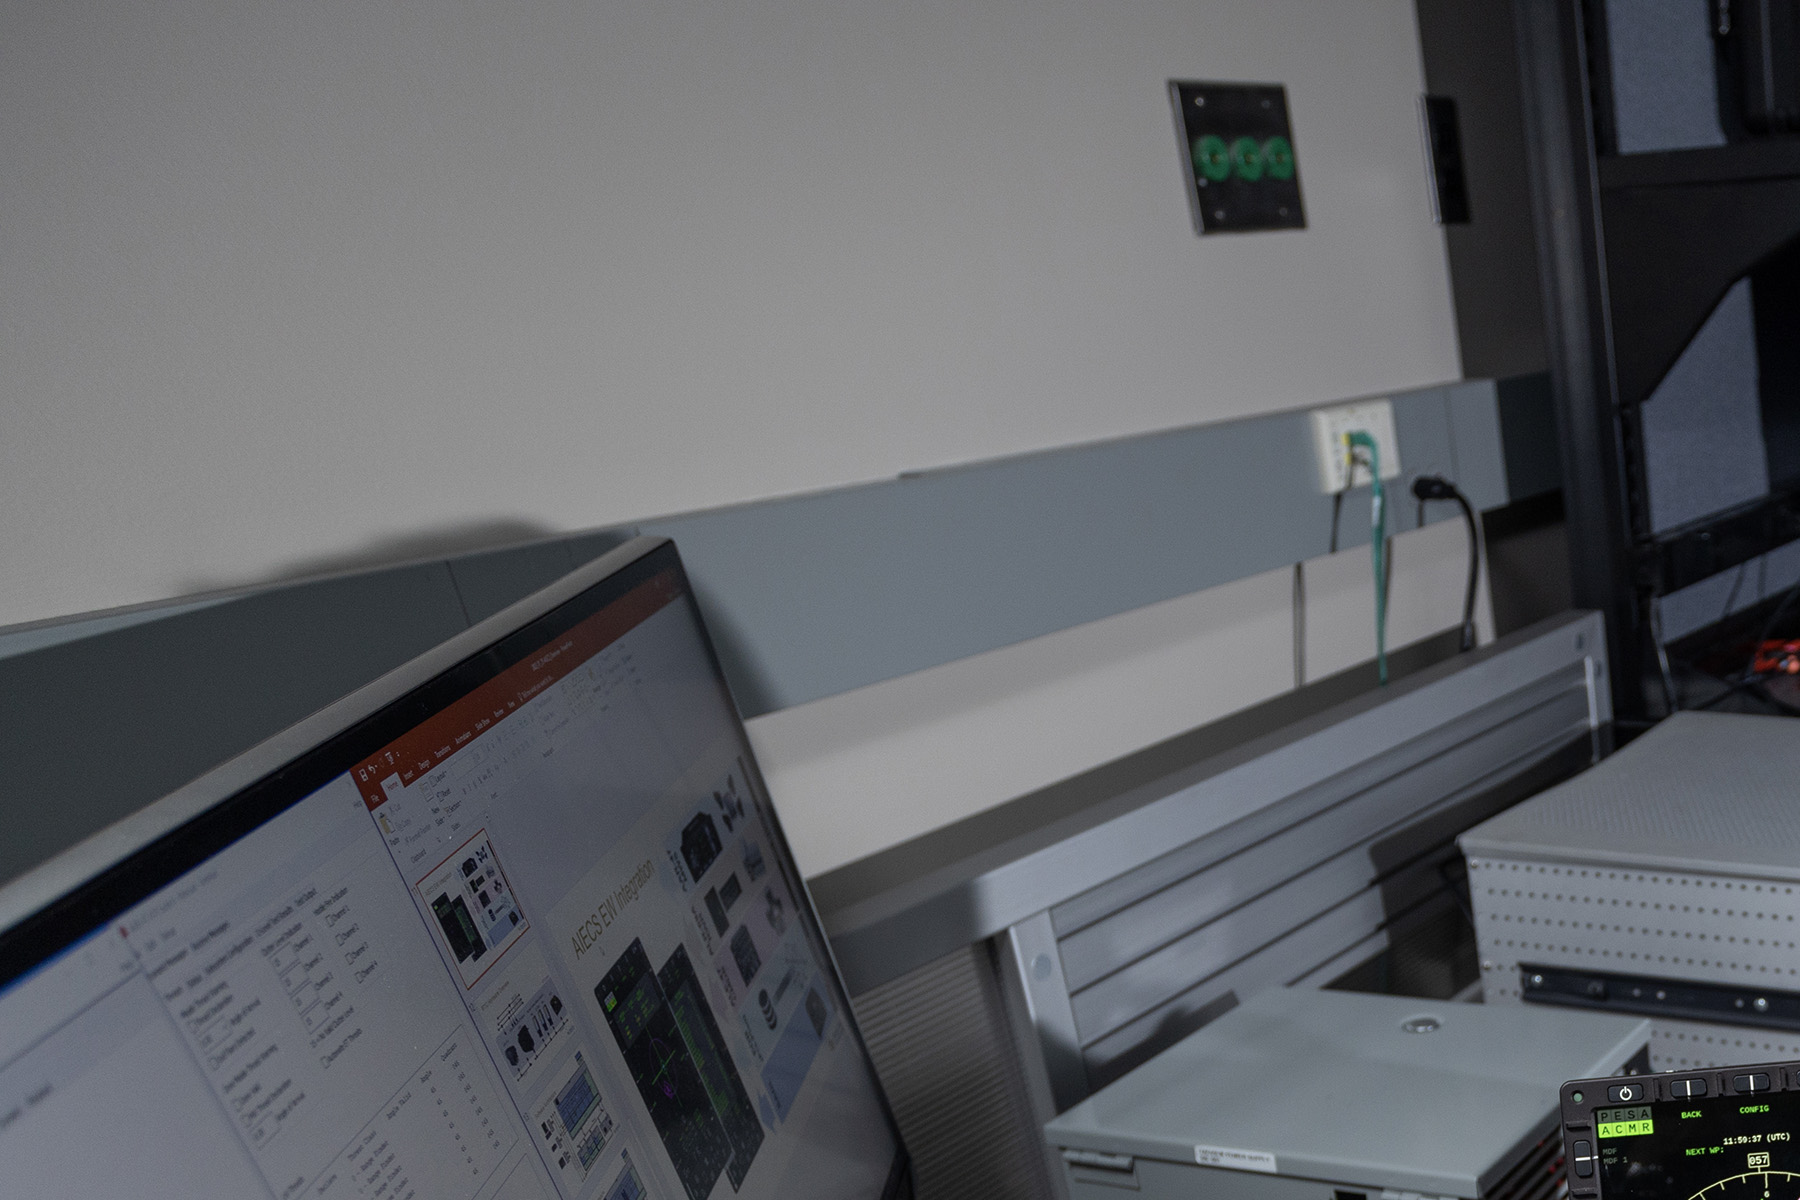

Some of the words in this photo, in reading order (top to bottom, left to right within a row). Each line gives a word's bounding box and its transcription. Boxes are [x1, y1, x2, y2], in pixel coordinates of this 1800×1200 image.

[386, 780, 398, 792] Home
[568, 910, 605, 961] AIECS
[596, 893, 620, 930] EW
[612, 854, 658, 917] Integration
[1681, 1110, 1702, 1119] BACK
[1739, 1105, 1770, 1114] CONFIG
[1723, 1134, 1762, 1145] 11:59:37
[1766, 1132, 1791, 1143] (UTC)
[1685, 1147, 1705, 1156] NEXT
[1709, 1146, 1724, 1154] WP:
[1748, 1155, 1768, 1165] 057
